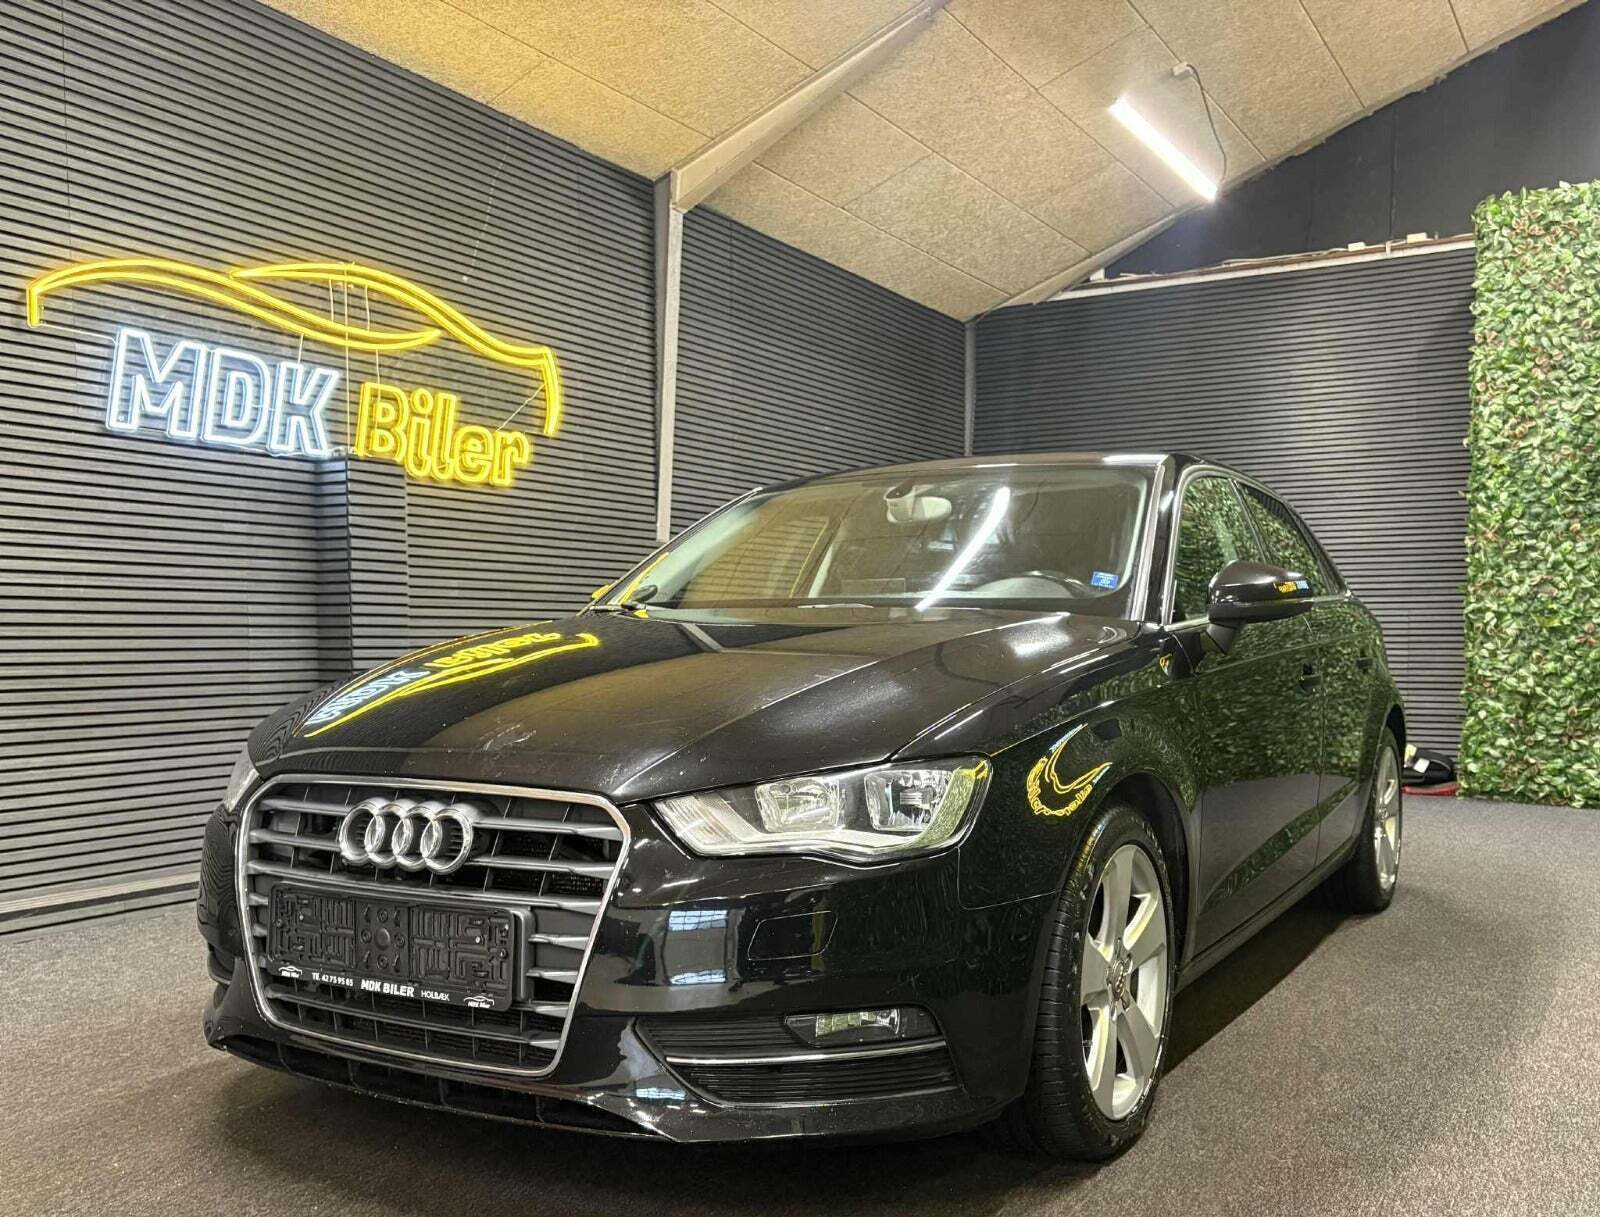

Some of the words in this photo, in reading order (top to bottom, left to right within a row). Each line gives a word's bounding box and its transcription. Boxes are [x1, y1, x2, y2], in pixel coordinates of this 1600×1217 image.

[106, 326, 340, 457] MDK
[356, 381, 531, 487] Biler
[360, 979, 381, 992] MDK
[382, 981, 415, 998] BILER
